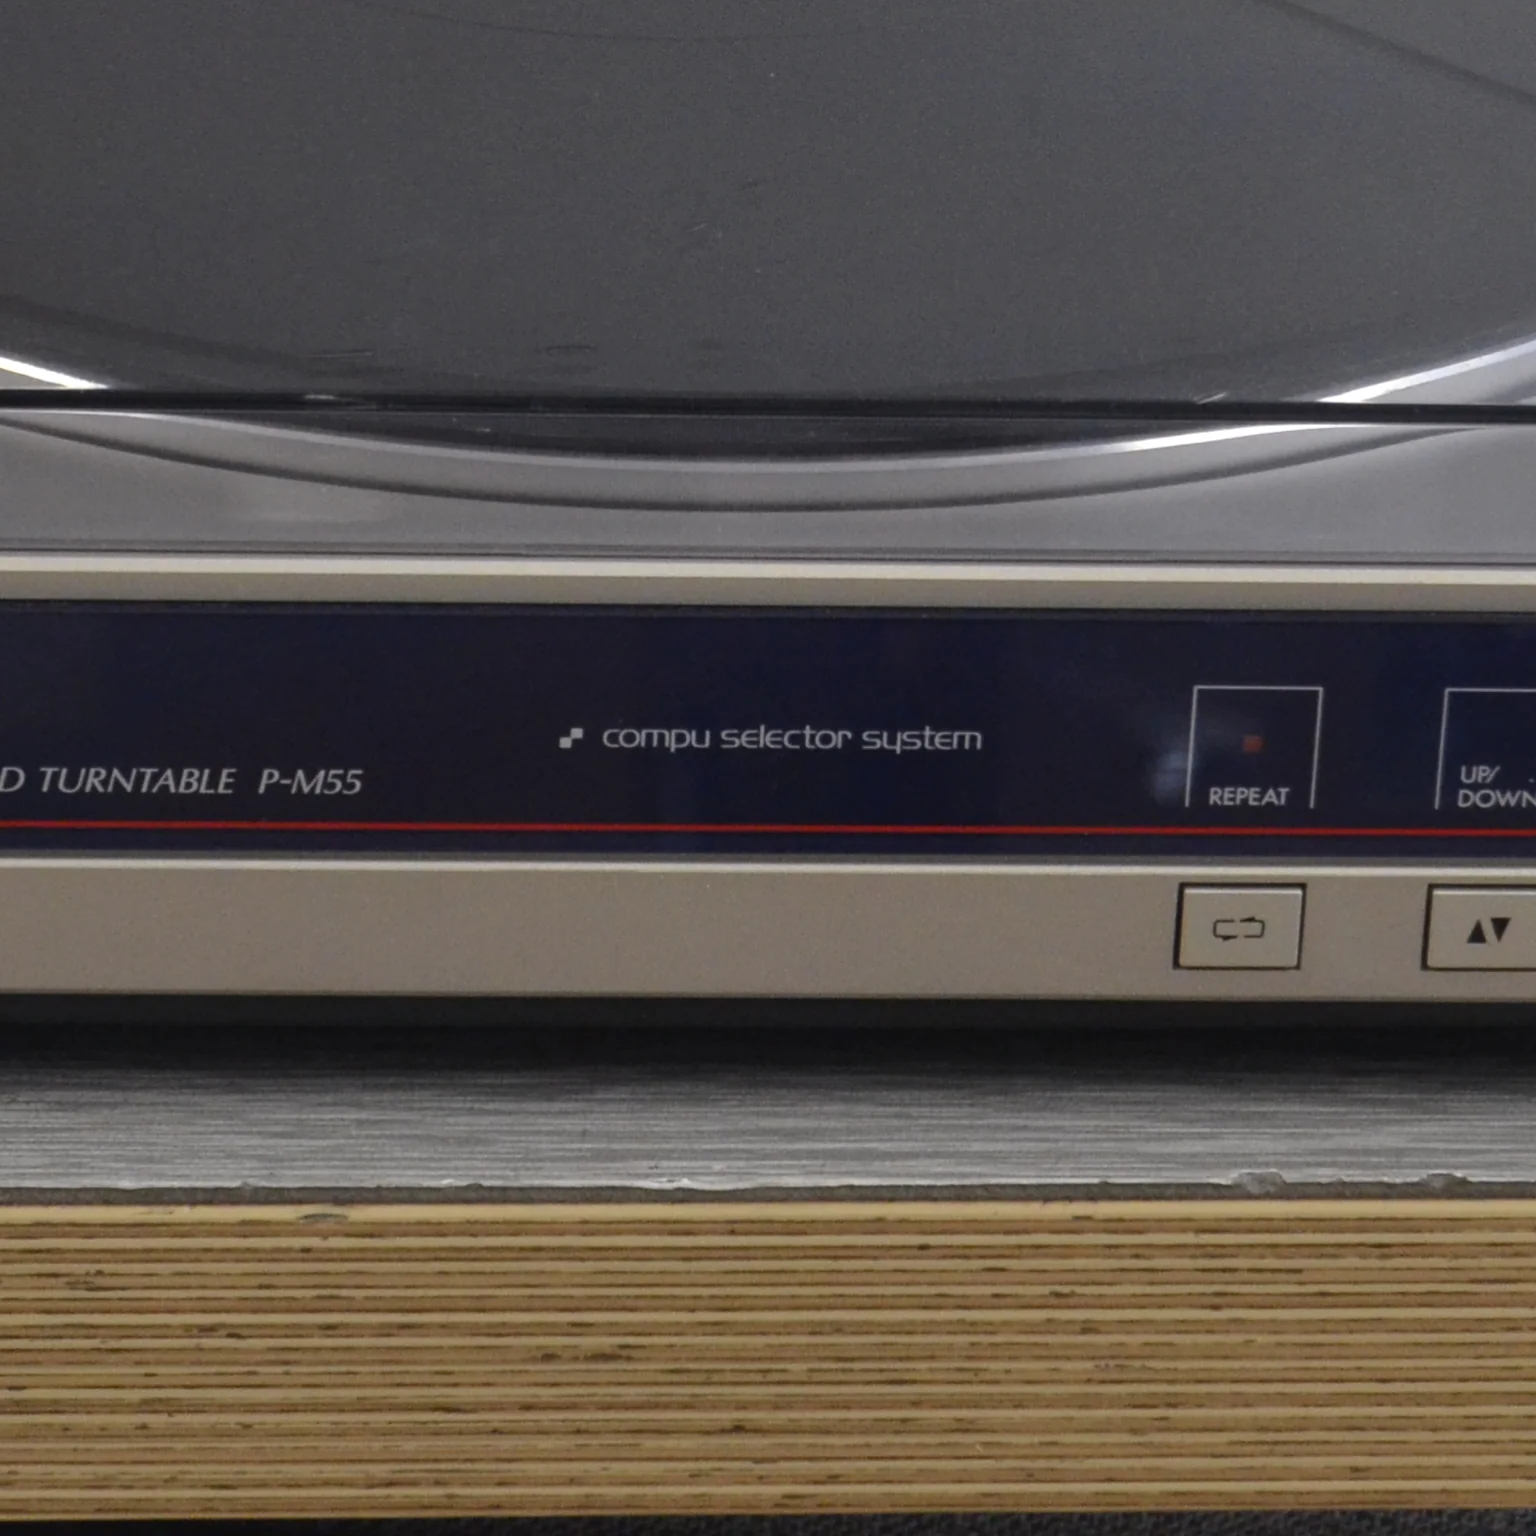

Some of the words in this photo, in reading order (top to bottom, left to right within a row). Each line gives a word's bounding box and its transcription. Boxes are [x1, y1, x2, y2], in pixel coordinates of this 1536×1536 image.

[602, 728, 711, 753] compu
[720, 724, 853, 750] selector
[861, 725, 982, 755] system
[39, 767, 237, 794] TURNTABLE
[258, 768, 364, 795] P-M55
[1460, 765, 1500, 784] UP/
[1209, 786, 1290, 806] REPEAT
